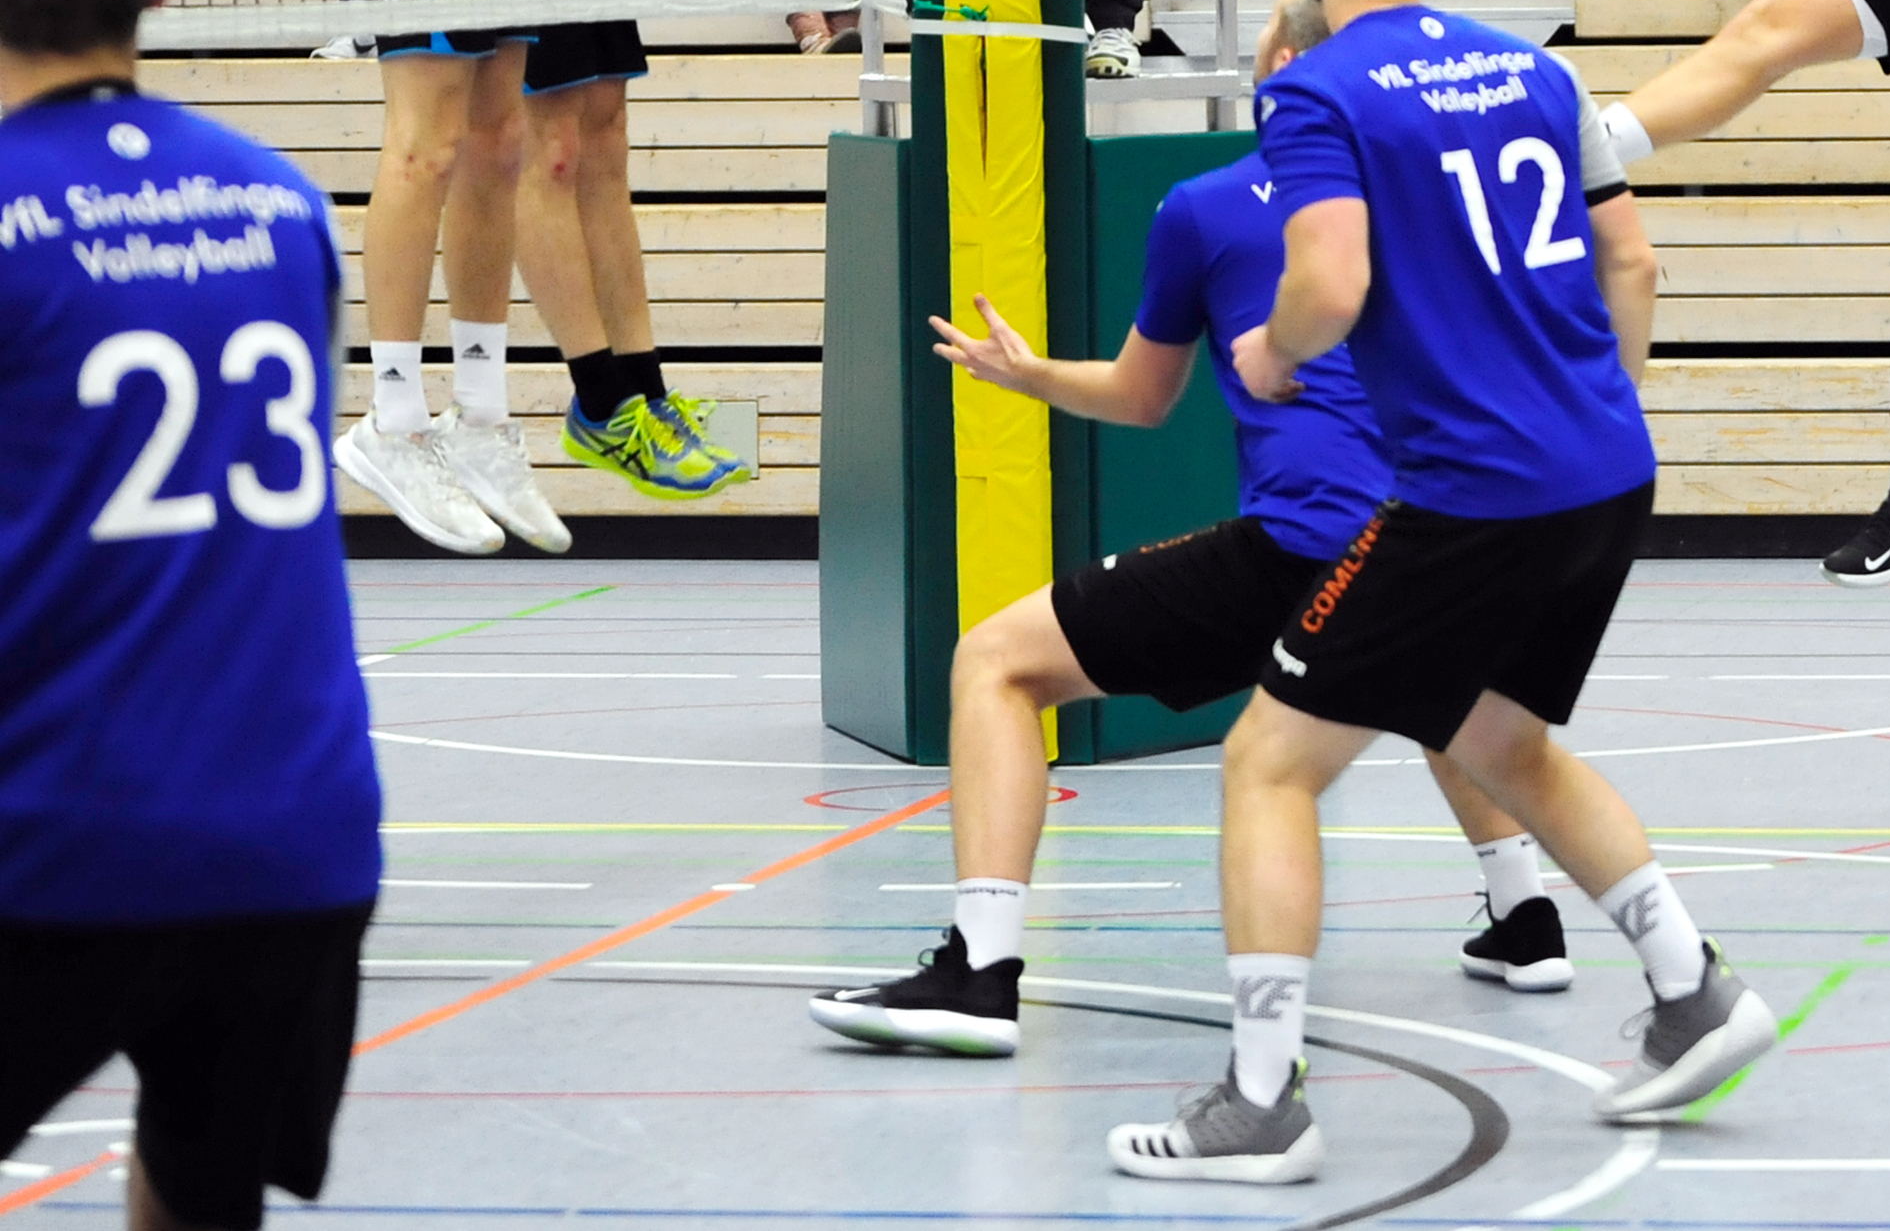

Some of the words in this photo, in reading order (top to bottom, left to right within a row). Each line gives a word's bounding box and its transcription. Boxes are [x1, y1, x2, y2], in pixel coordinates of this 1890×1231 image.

[1419, 75, 1528, 115] Volleyball
[73, 222, 277, 285] Volleyball
[1440, 136, 1586, 276] 12
[77, 320, 327, 542] 23
